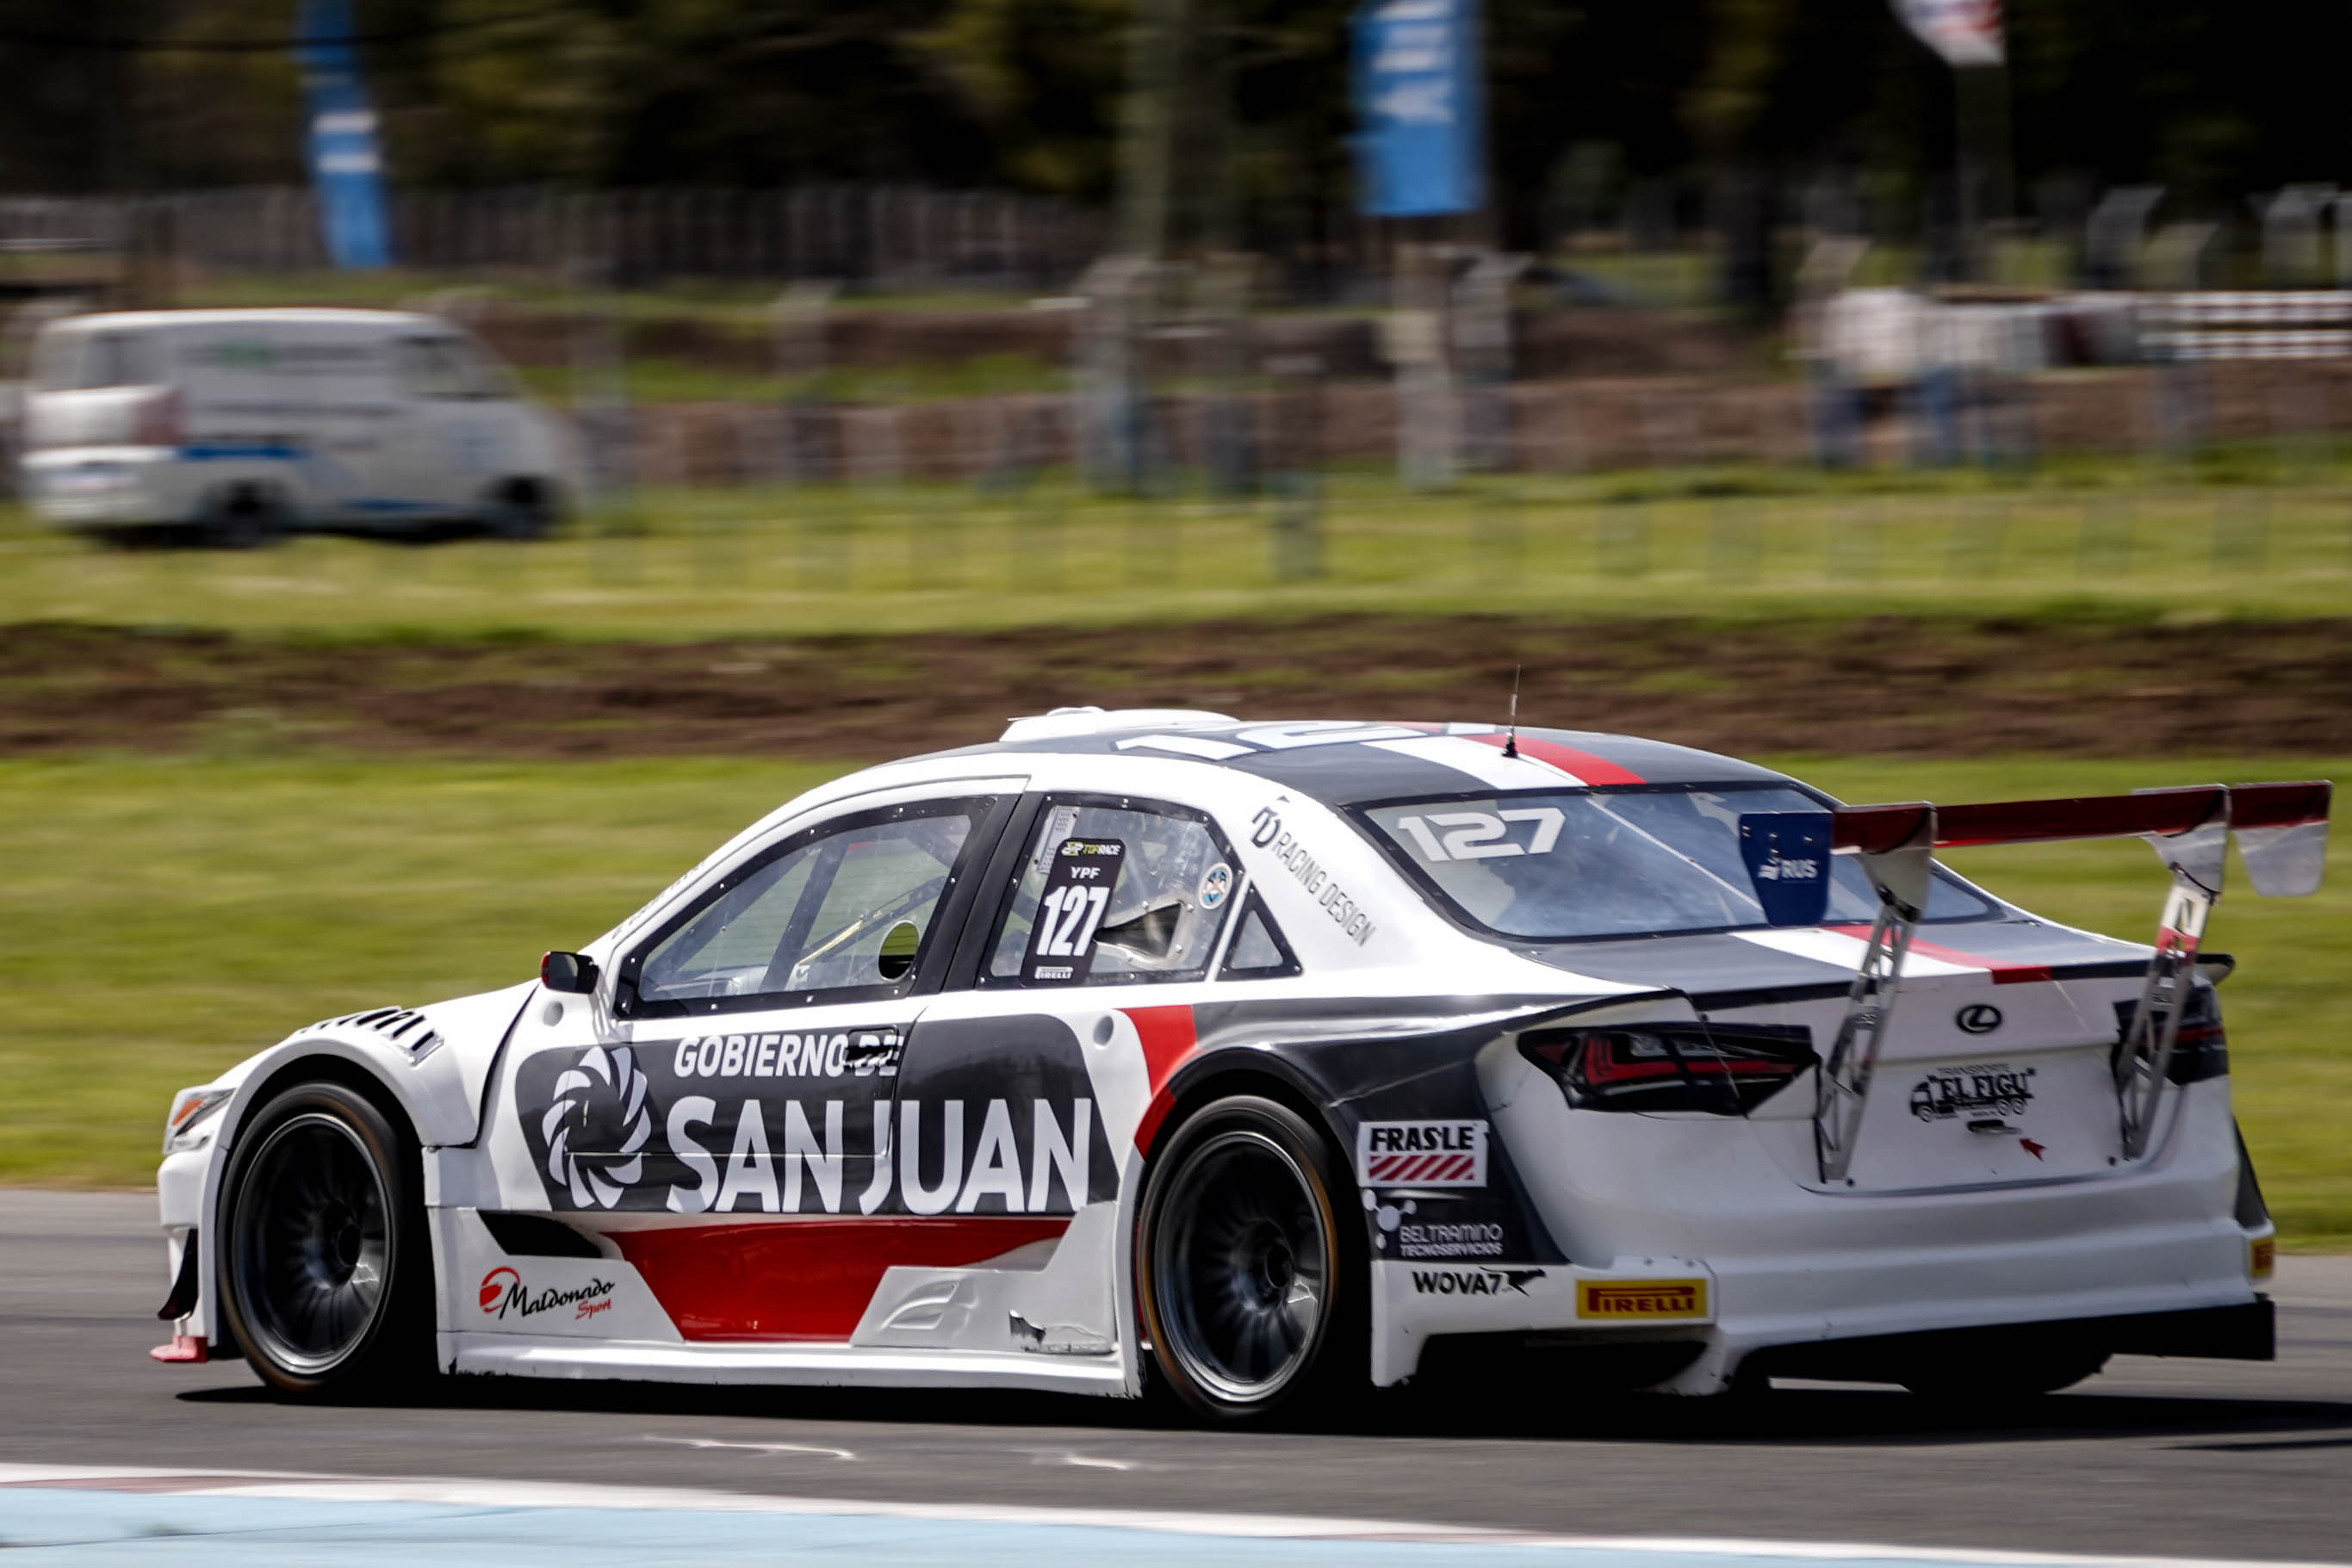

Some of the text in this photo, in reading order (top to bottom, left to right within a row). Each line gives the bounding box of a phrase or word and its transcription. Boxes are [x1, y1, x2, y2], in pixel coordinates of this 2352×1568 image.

[1399, 808, 1566, 861] 127
[1071, 866, 1102, 879] YPF
[1781, 858, 1819, 879] RUS
[1271, 832, 1327, 895] RACING
[1318, 883, 1377, 947] DESIGN
[1036, 884, 1110, 957] 127
[1035, 966, 1074, 980] PIRELLI
[673, 1034, 849, 1077] GOBIERNO
[667, 1096, 1092, 1216] SAN JUAN
[499, 1278, 616, 1320] Maldonado
[1412, 1271, 1503, 1295] WOVA7
[1587, 1286, 1696, 1312] PIRELLI
[574, 1298, 611, 1320] Sport
